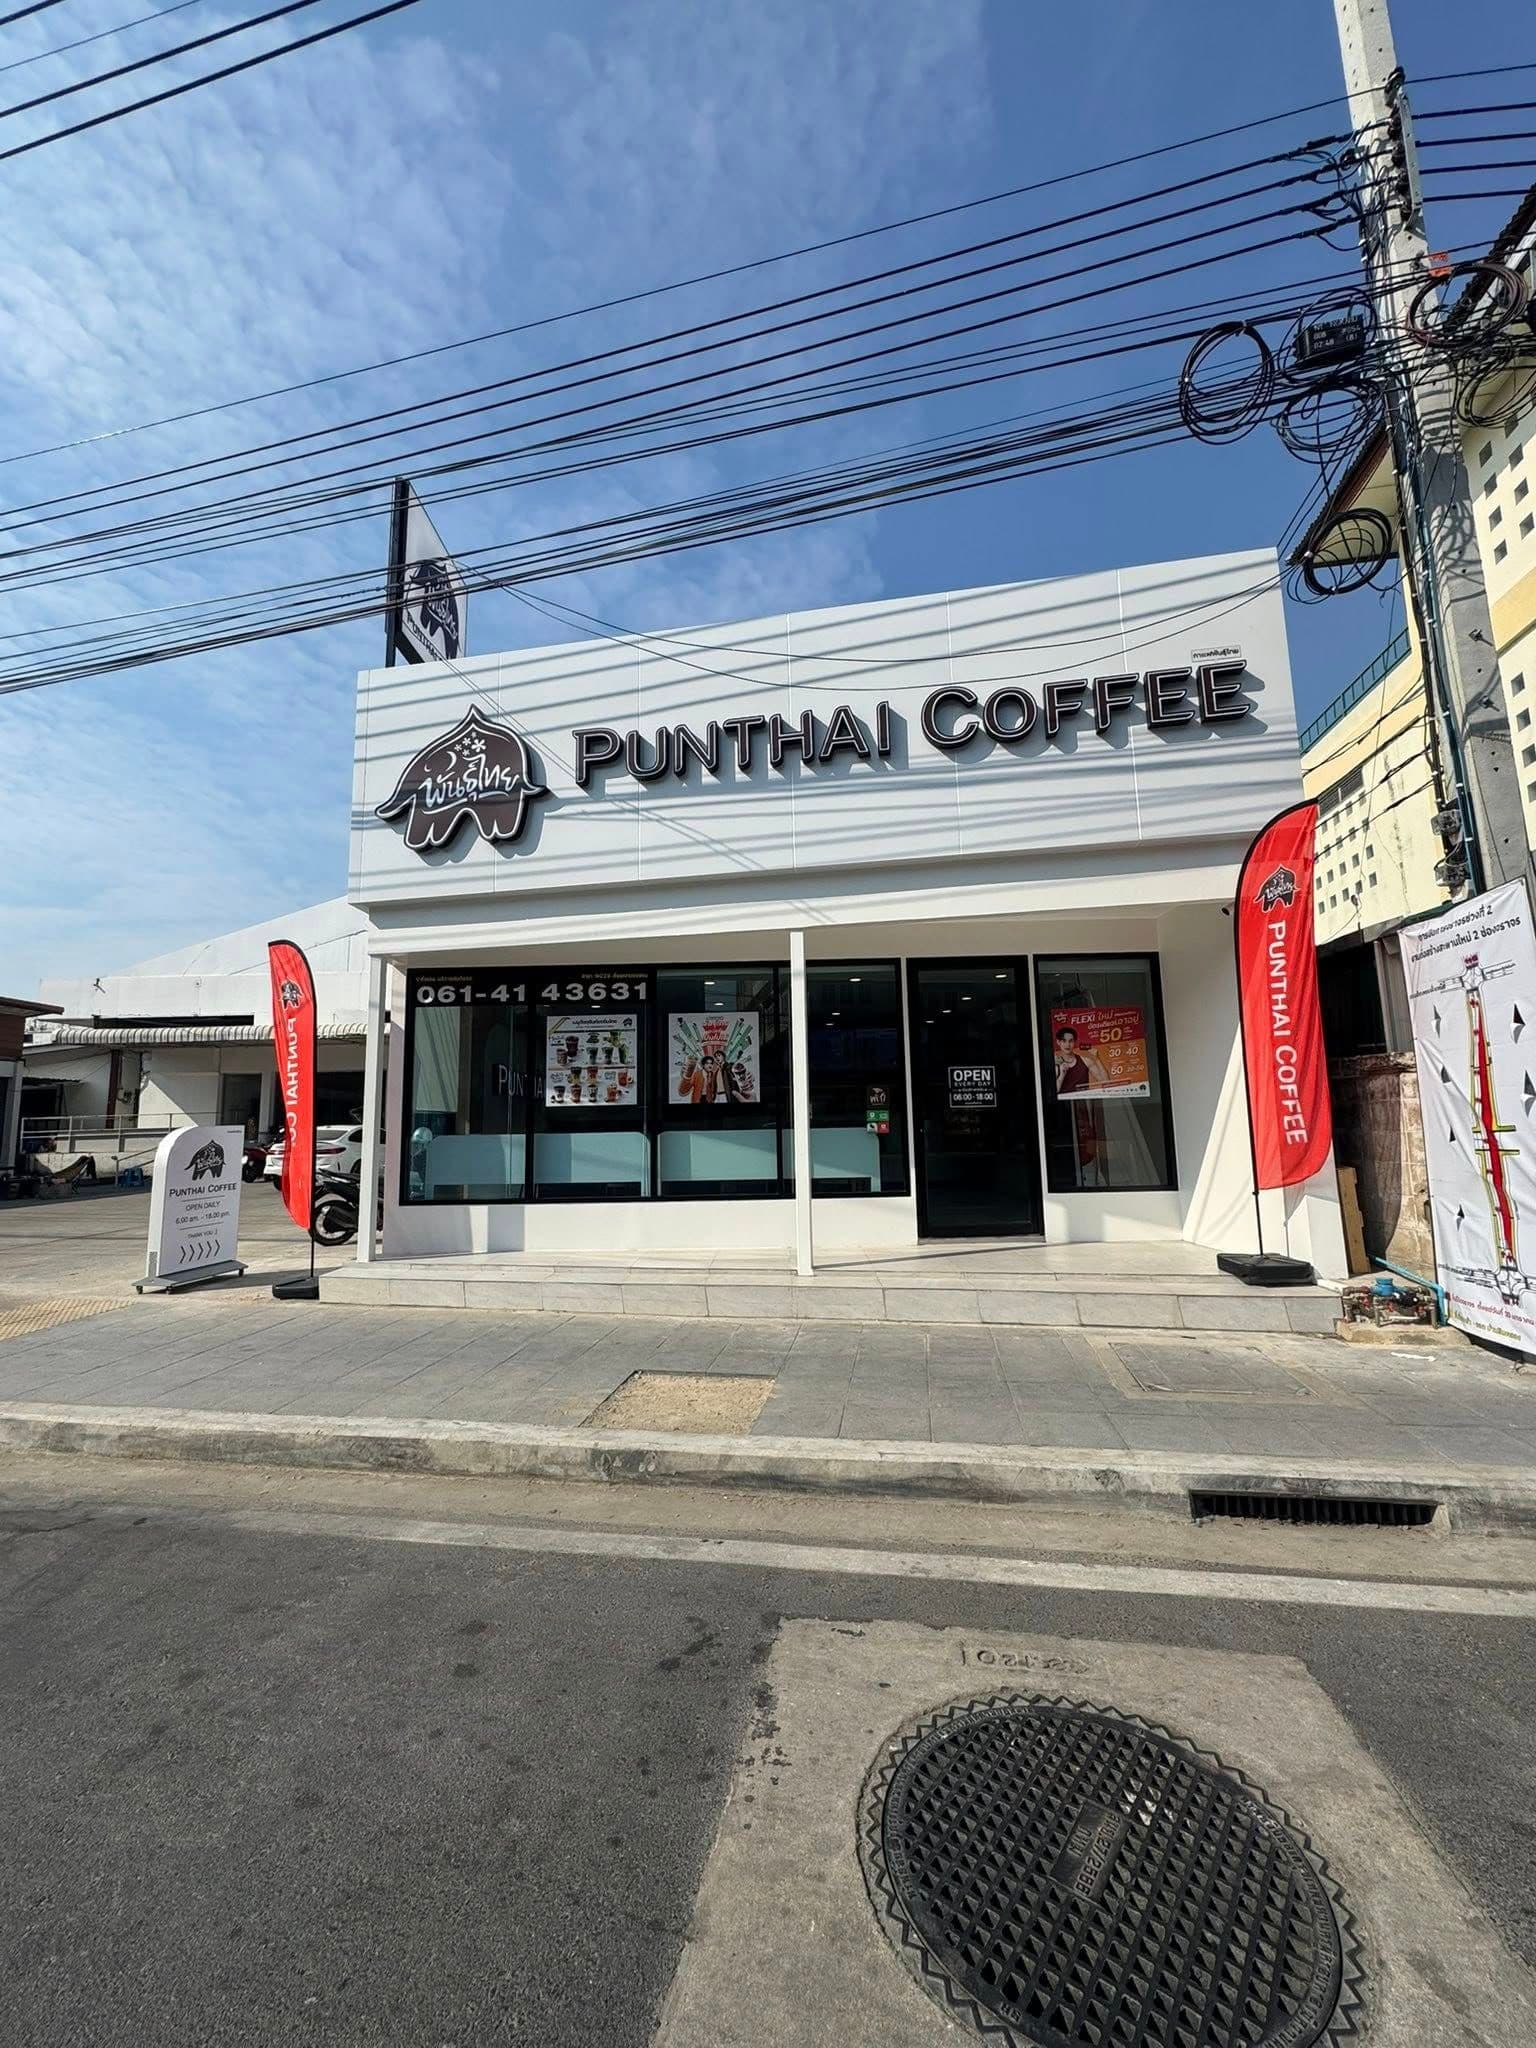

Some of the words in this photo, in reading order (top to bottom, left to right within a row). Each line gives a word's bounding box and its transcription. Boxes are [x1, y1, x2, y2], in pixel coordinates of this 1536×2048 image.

[572, 701, 889, 786] PUNTHAI
[920, 659, 1251, 750] COFFEE
[418, 752, 520, 808] พันธุ์ไทย
[1268, 920, 1291, 1037] PUNTHAI
[416, 984, 526, 1004] 061-41
[541, 982, 647, 1001] 43631
[1100, 1027, 1122, 1043] 50
[953, 1070, 991, 1081] OPEN
[1275, 1045, 1308, 1145] COFFEE
[169, 1186, 205, 1198] PUNTHAI
[207, 1182, 237, 1194] COFFEE
[185, 1202, 203, 1212] OPEN
[204, 1200, 221, 1209] DAILY
